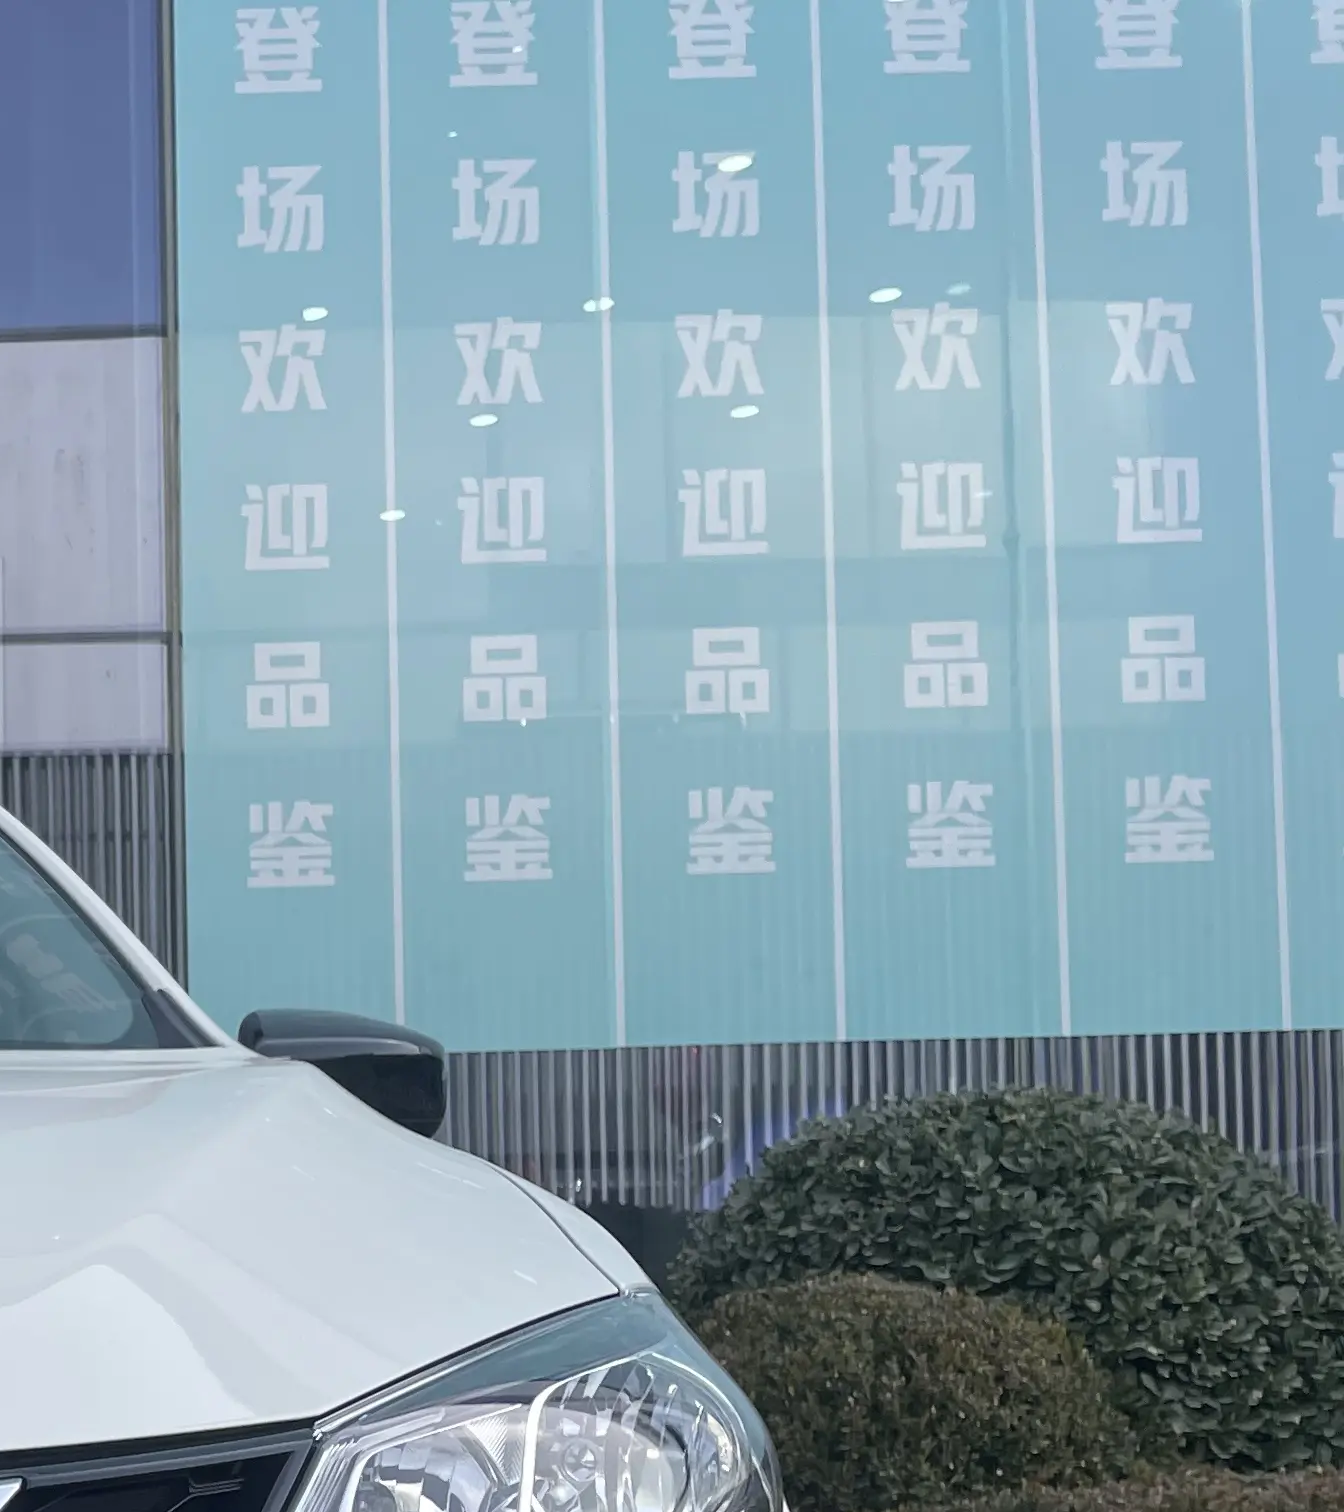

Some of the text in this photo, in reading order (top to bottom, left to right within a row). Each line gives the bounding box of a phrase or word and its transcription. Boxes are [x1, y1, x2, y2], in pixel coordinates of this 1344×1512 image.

[234, 7, 335, 888] 登场欢迎品鉴
[449, 0, 553, 882] 登场欢迎品鉴
